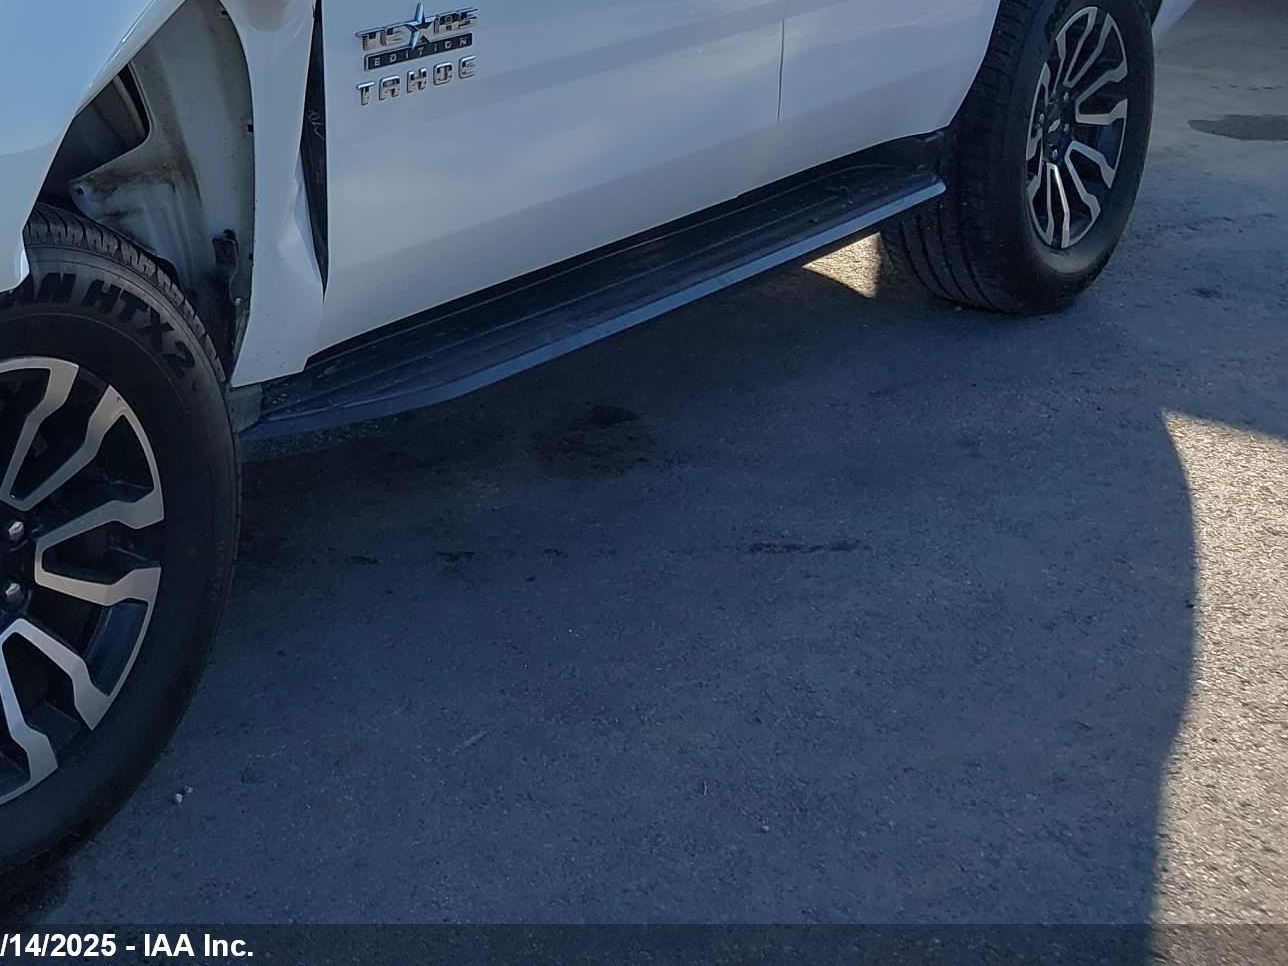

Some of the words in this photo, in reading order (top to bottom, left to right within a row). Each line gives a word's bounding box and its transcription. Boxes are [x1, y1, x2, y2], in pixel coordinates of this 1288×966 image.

[354, 3, 480, 51] TEXAS
[373, 36, 467, 67] EDITION
[355, 55, 477, 106] TAHOE
[80, 278, 196, 379] HTX2
